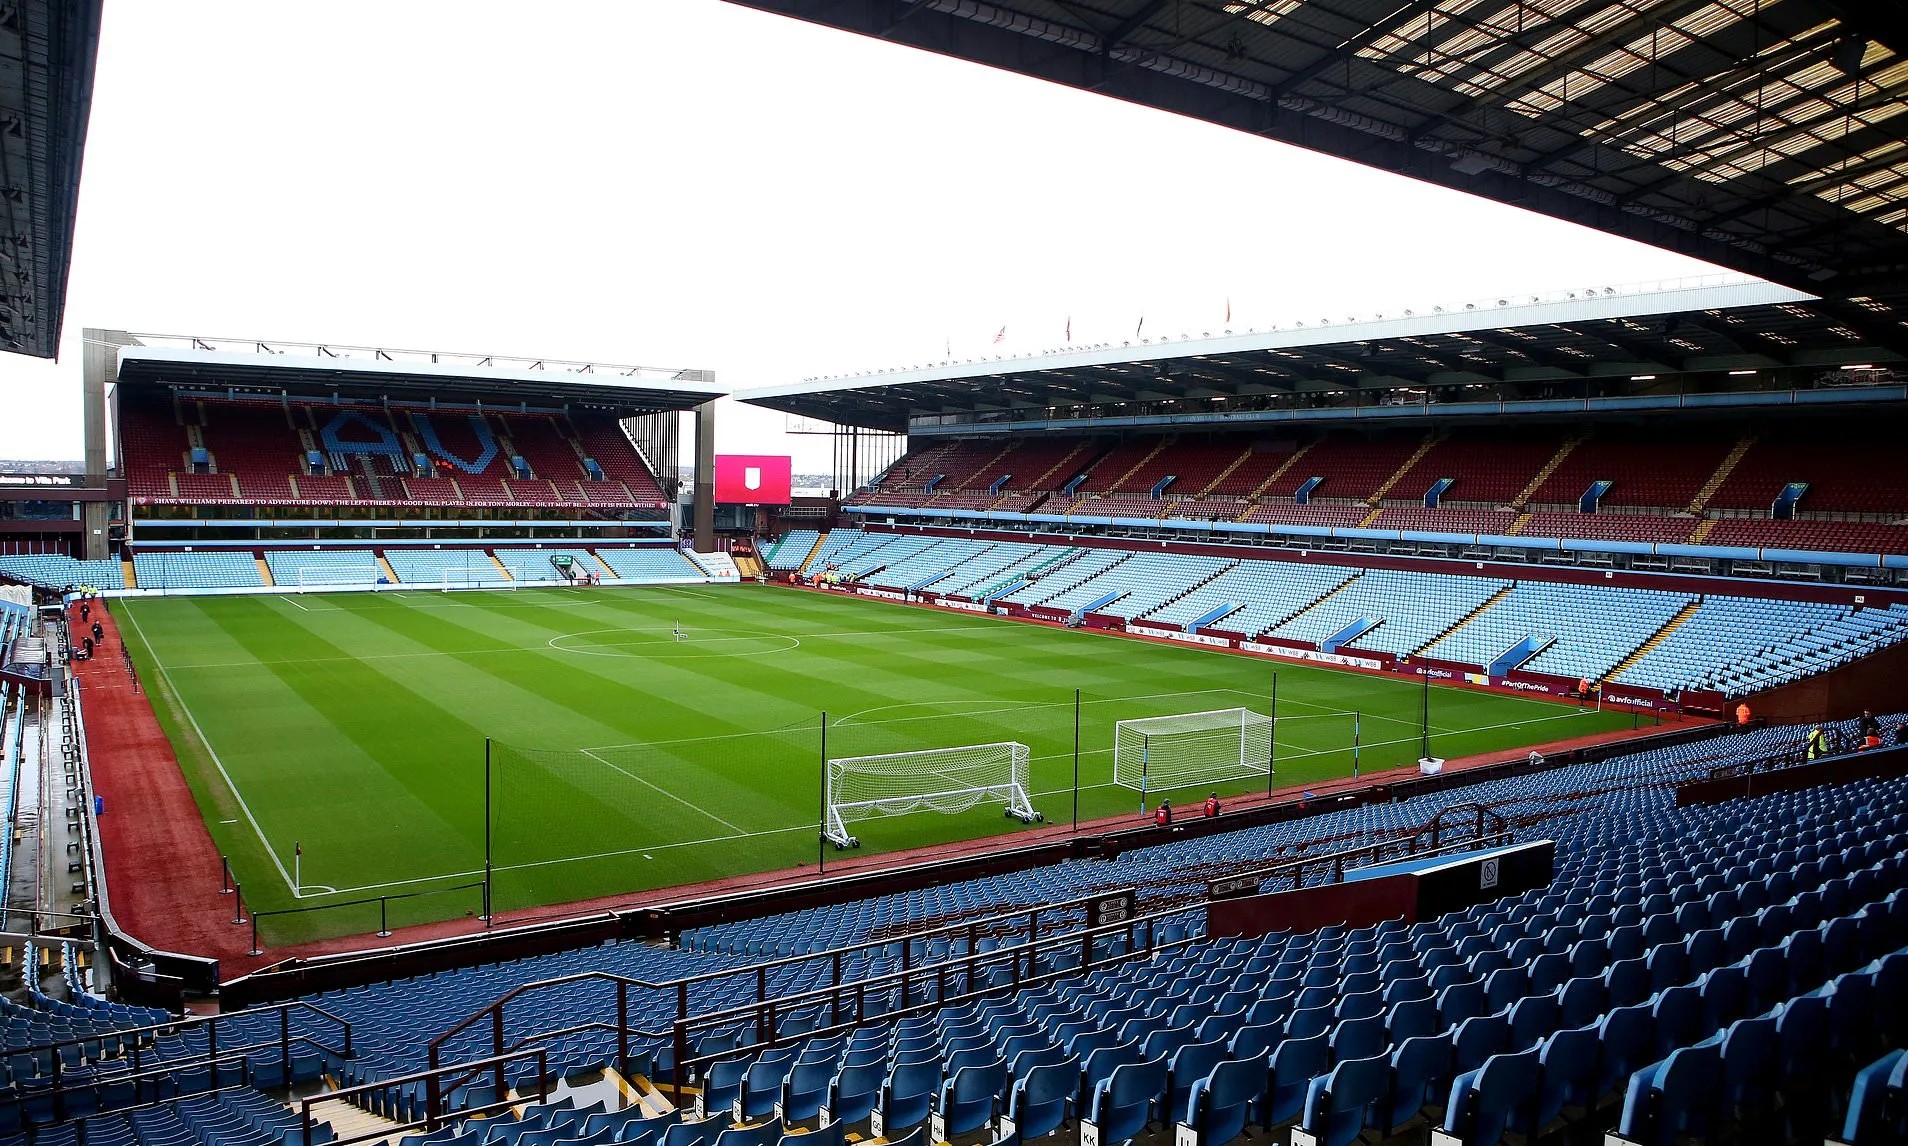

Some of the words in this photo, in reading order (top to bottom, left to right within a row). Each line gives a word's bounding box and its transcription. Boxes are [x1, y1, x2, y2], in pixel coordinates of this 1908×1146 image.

[320, 410, 498, 474] AV
[53, 476, 72, 485] Park
[1501, 680, 1549, 692] #PartOfThePride
[872, 1119, 882, 1132] GG
[933, 1123, 943, 1137] HH
[1083, 1132, 1097, 1146] KK
